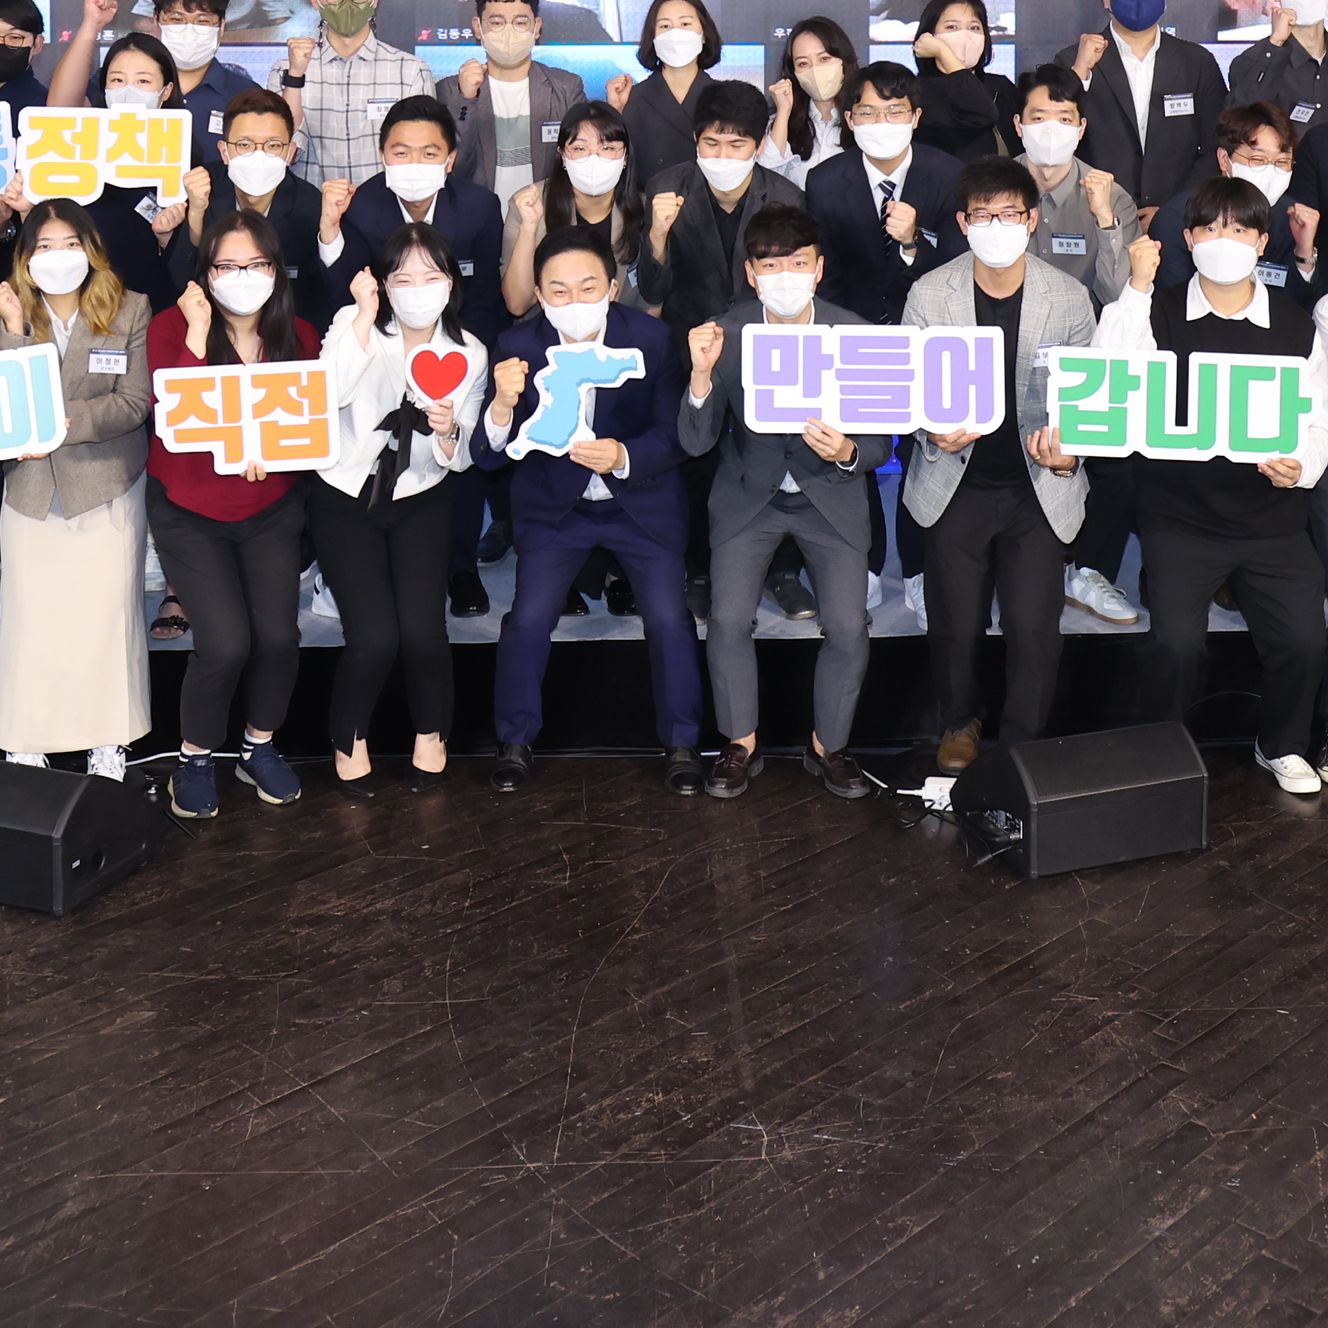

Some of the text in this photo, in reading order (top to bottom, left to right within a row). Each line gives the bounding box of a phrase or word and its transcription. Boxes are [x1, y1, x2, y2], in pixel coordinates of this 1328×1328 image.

[436, 28, 473, 40] 김동우
[25, 110, 184, 199] 정책
[165, 370, 330, 464] 직접
[752, 334, 995, 427] 만들어
[1057, 355, 1313, 455] 갑니다
